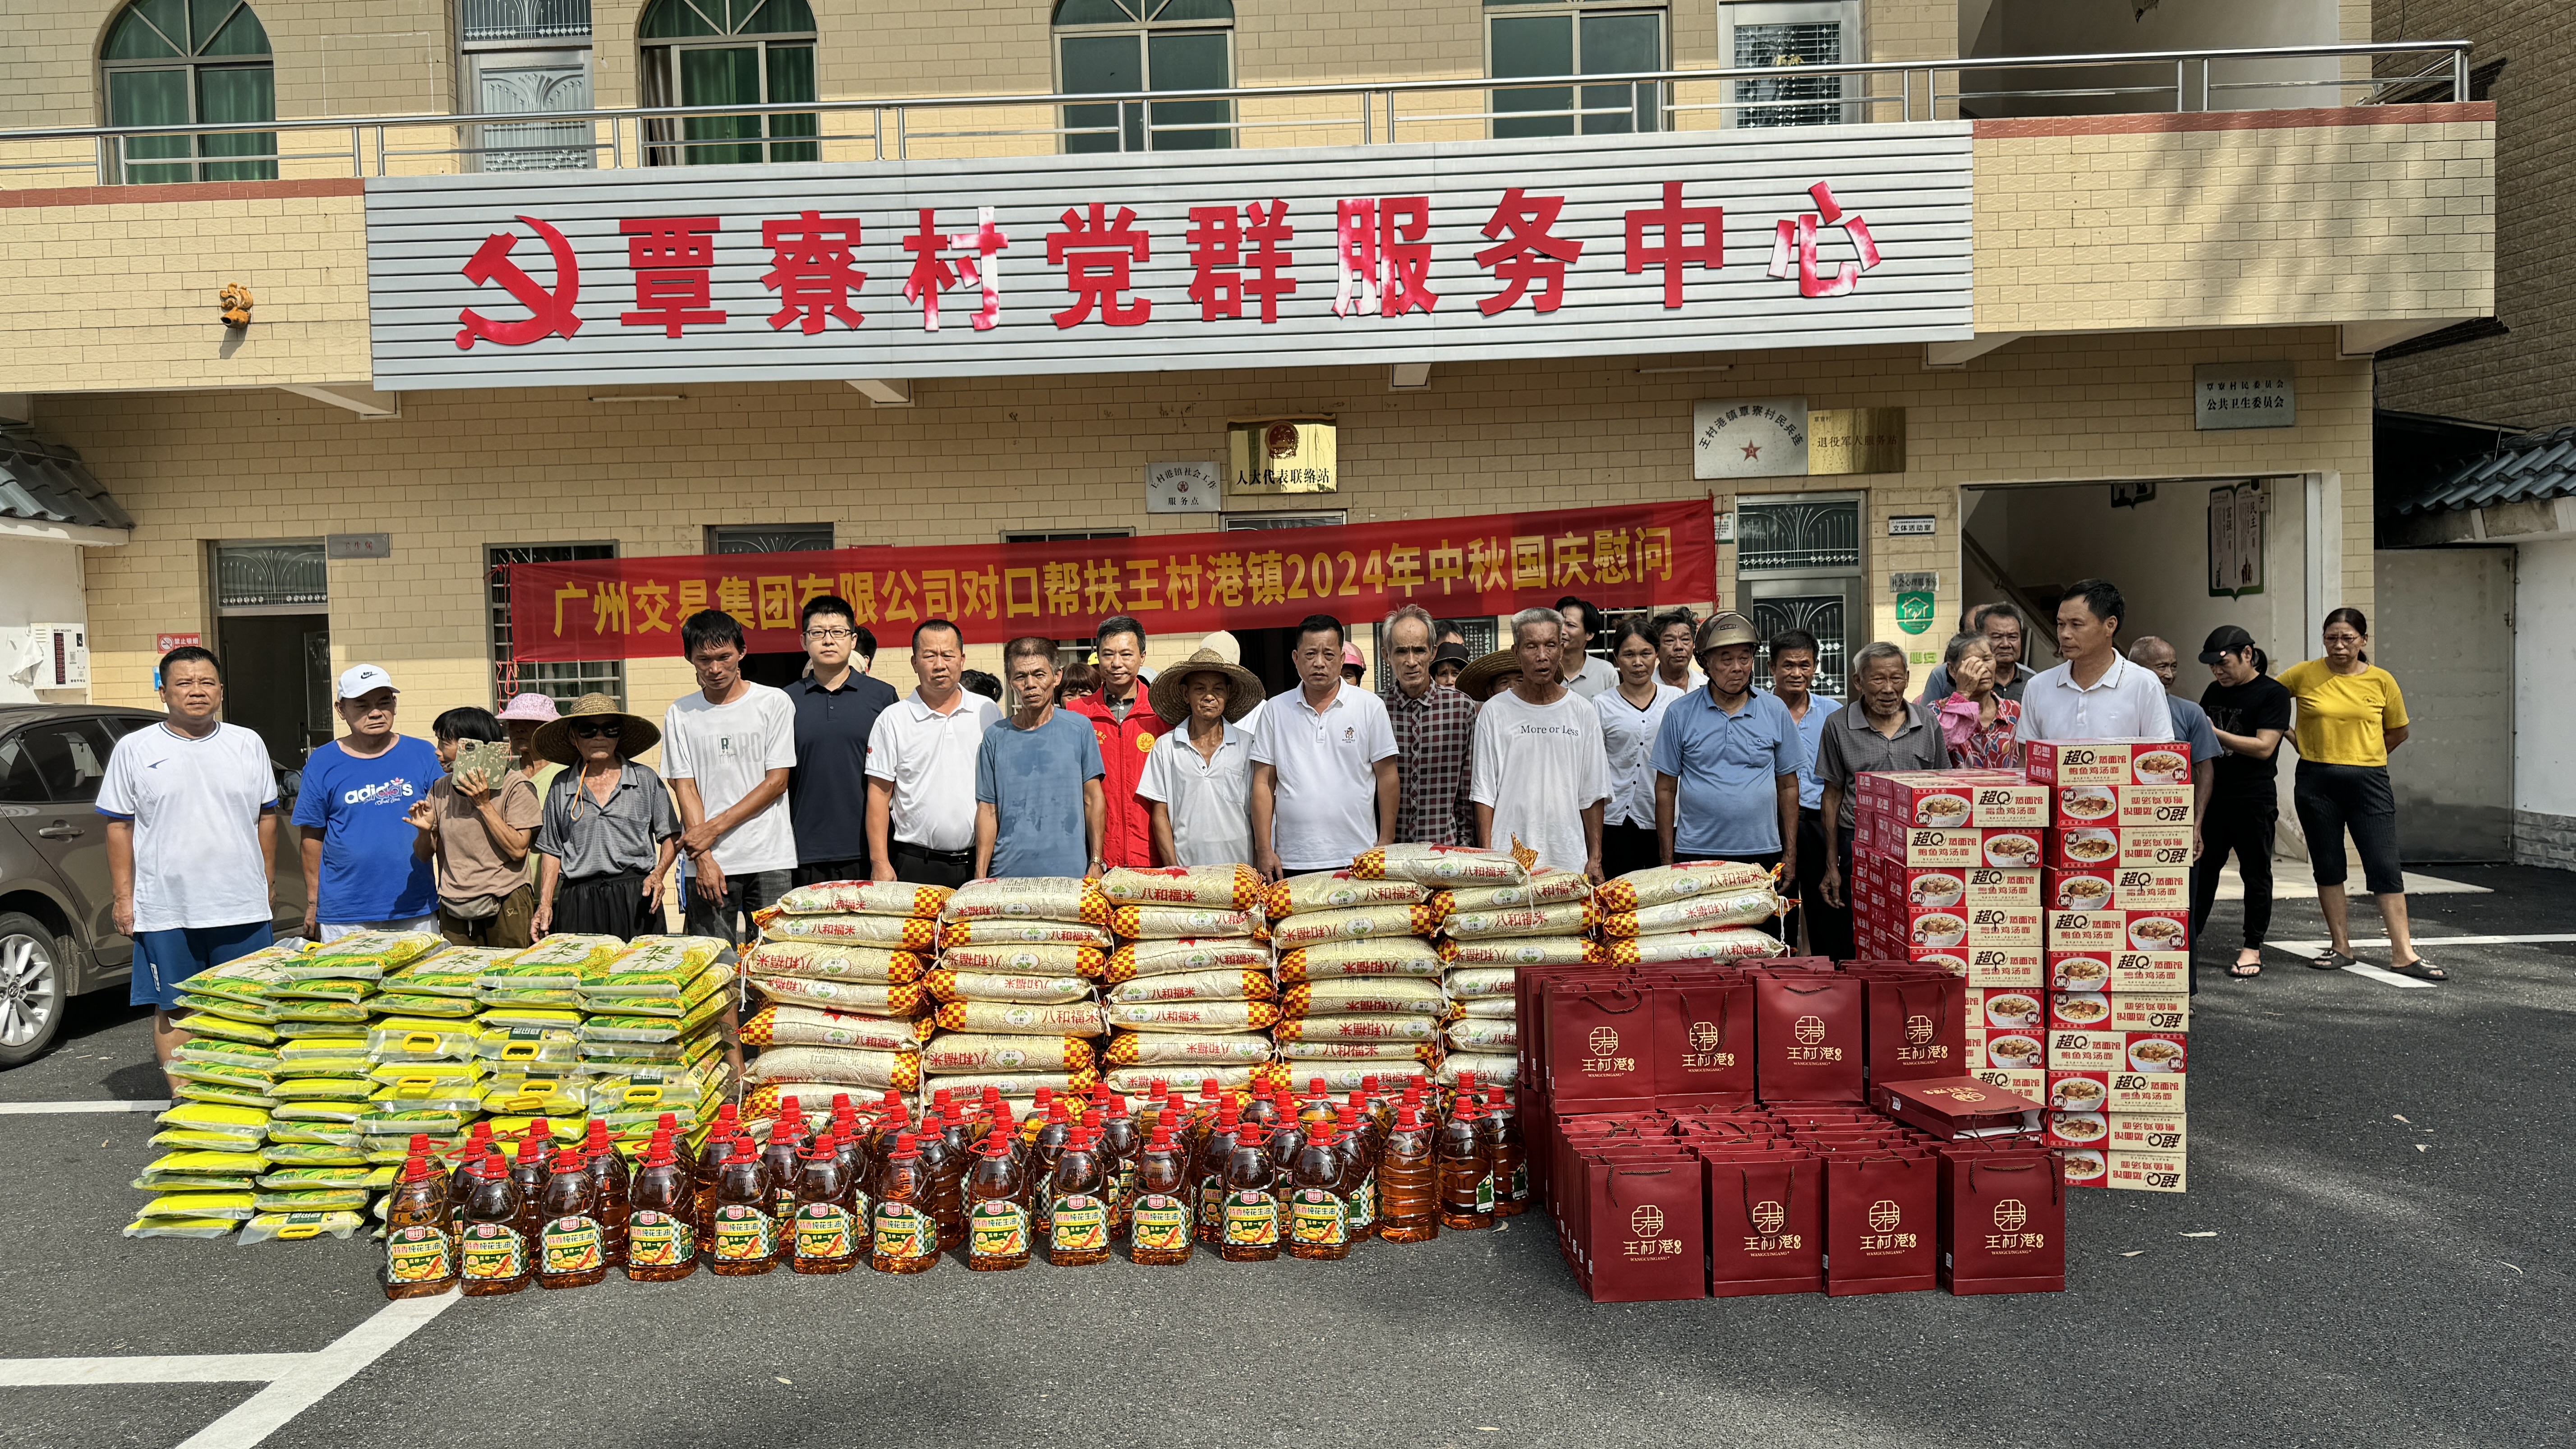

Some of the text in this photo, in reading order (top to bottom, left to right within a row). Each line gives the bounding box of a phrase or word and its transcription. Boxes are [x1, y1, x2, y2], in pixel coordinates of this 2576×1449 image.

[620, 179, 1881, 338] 覃寮村党群服务中心
[2207, 396, 2284, 410] 公共卫生委员会
[1699, 405, 1803, 450] 王村港镇覃寮村民兵连
[1817, 435, 1897, 448] 退役军人服务站
[1150, 467, 1217, 490] 王村港镇社会工作
[1236, 469, 1329, 486] 人大代表联络站
[1168, 497, 1199, 506] 服务点
[1521, 725, 1546, 734] More
[1563, 725, 1579, 736] Less
[345, 782, 413, 804] adidas
[1463, 866, 1507, 877] 八和福米
[1710, 871, 1760, 887] 八和福米
[1365, 885, 1419, 900] 八和福米
[1531, 879, 1580, 897] 八和福米
[1141, 888, 1195, 902] 八和福米
[825, 900, 866, 911] 八和福米
[957, 906, 1001, 916] 八和福米
[1686, 901, 1728, 918] 八和福米
[1496, 911, 1547, 927] 八和福米
[812, 924, 856, 935] 八和福米
[1051, 931, 1094, 941] 八和福米
[1283, 924, 1338, 942] 八和福米
[1721, 943, 1764, 955] 八和福米
[757, 953, 811, 970] 八和福米
[948, 953, 1002, 967] 八和福米
[1214, 954, 1257, 965] 八和福米
[1343, 960, 1398, 974] 八和福米
[1004, 979, 1049, 990] 八和福米
[1151, 987, 1195, 999] 八和福米
[1042, 1010, 1100, 1023] 八和福米
[1156, 1011, 1200, 1022] 八和福米
[1339, 1023, 1394, 1036] 八和福米
[855, 1036, 899, 1048] 八和福米
[1187, 1043, 1230, 1054] 八和福米
[1323, 1043, 1378, 1057] 八和福米
[1787, 1047, 1834, 1061] 王村港
[929, 1049, 988, 1066] 八和福米
[1582, 1057, 1627, 1072] 王村港
[1136, 1211, 1178, 1220] 特香纯花生油
[1228, 1206, 1271, 1215] 特香纯花生油
[1294, 1205, 1336, 1214] 特香纯花生油
[974, 1218, 1017, 1228] 特香纯花生油
[1056, 1213, 1098, 1222] 特香纯花生油
[717, 1223, 758, 1231] 特香纯花生油
[798, 1221, 841, 1229] 特香纯花生油
[876, 1220, 915, 1229] 特香纯花生油
[548, 1233, 593, 1244] 特香纯花生油
[631, 1228, 671, 1237] 特香纯花生油
[392, 1241, 440, 1254] 特香纯花生油
[465, 1241, 511, 1250] 特香纯花生油
[1624, 1239, 1673, 1256] 王村港
[1860, 1233, 1909, 1251] 王村港
[1985, 1233, 2036, 1249] 王村港
